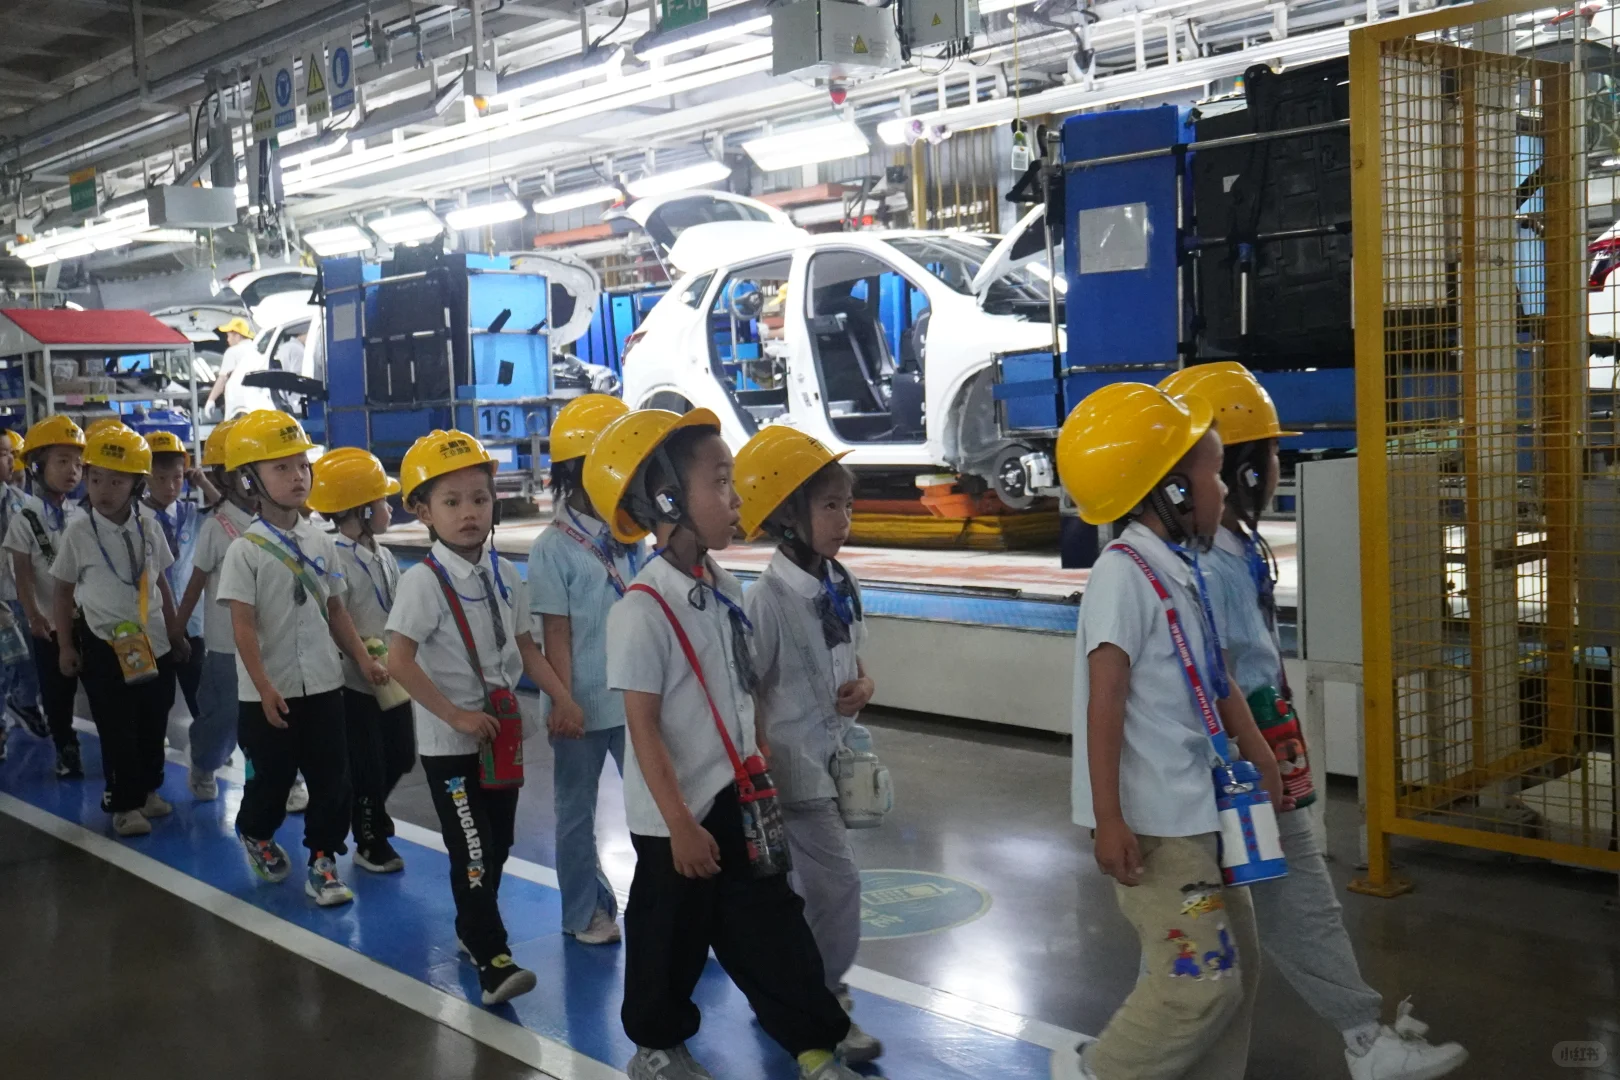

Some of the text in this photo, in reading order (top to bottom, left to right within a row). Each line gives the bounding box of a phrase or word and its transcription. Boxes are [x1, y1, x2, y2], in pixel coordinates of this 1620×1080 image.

[482, 409, 511, 433] 16
[1194, 685, 1218, 730] ULTRAMAN
[452, 795, 484, 889] SUGARDK
